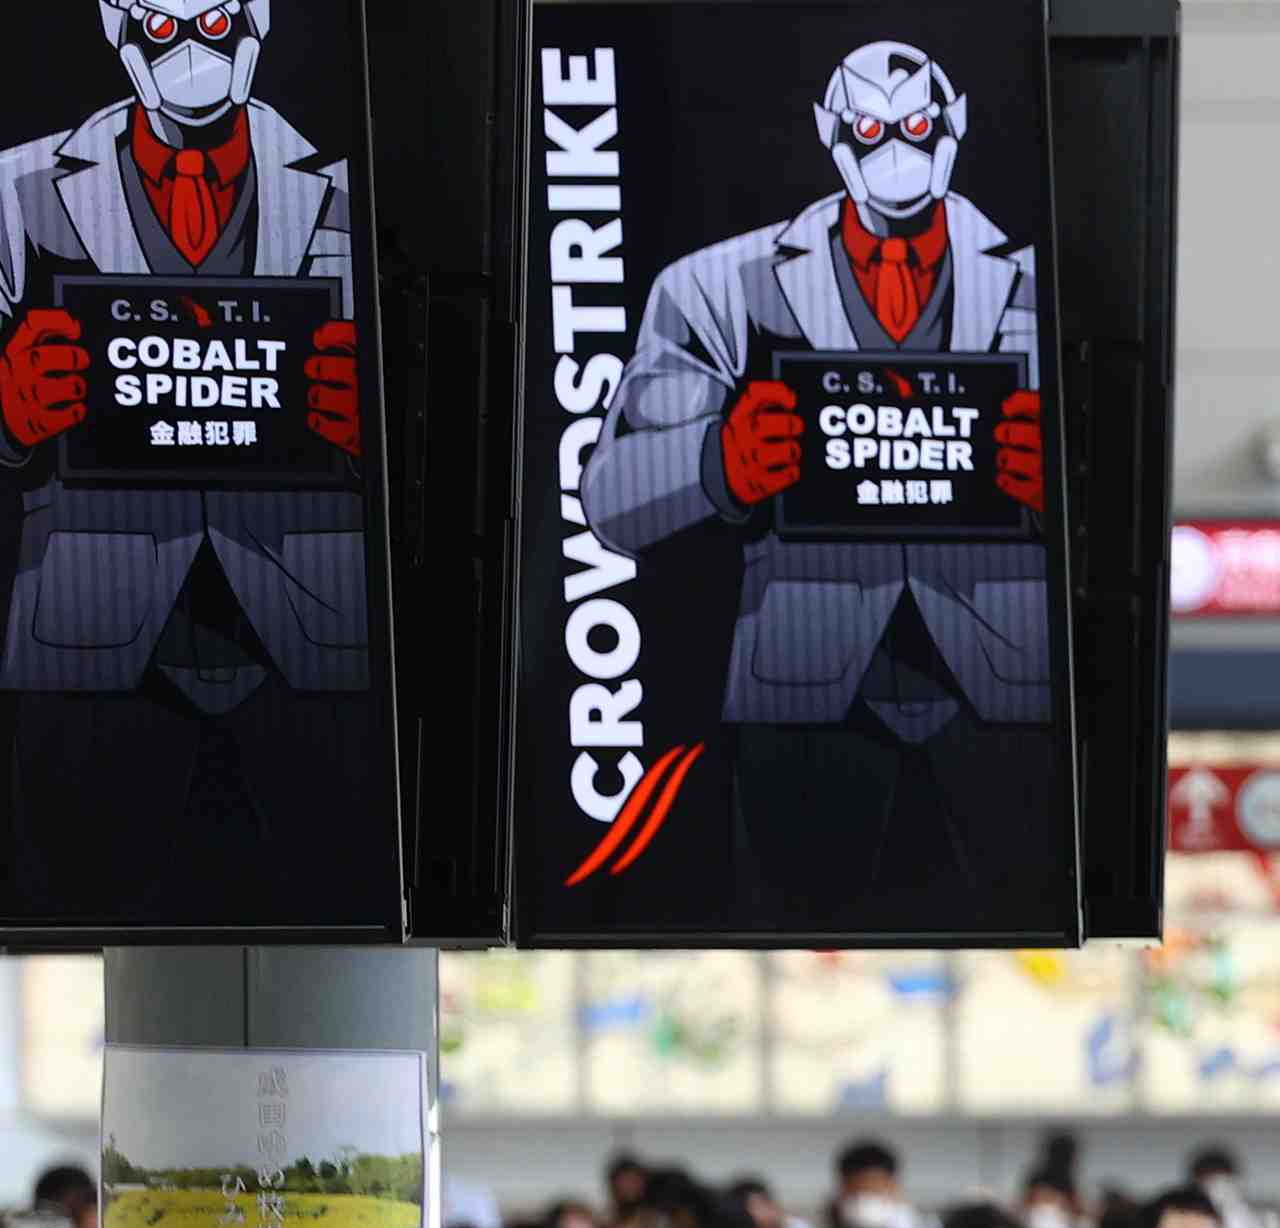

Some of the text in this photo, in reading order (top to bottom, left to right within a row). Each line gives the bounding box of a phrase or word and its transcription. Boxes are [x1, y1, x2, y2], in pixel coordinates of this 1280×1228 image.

[107, 336, 286, 371] COBALT
[114, 374, 281, 408] SPIDER
[150, 420, 257, 446] 金融犯罪
[819, 404, 979, 438] COBALT
[825, 438, 974, 470] SPIDER
